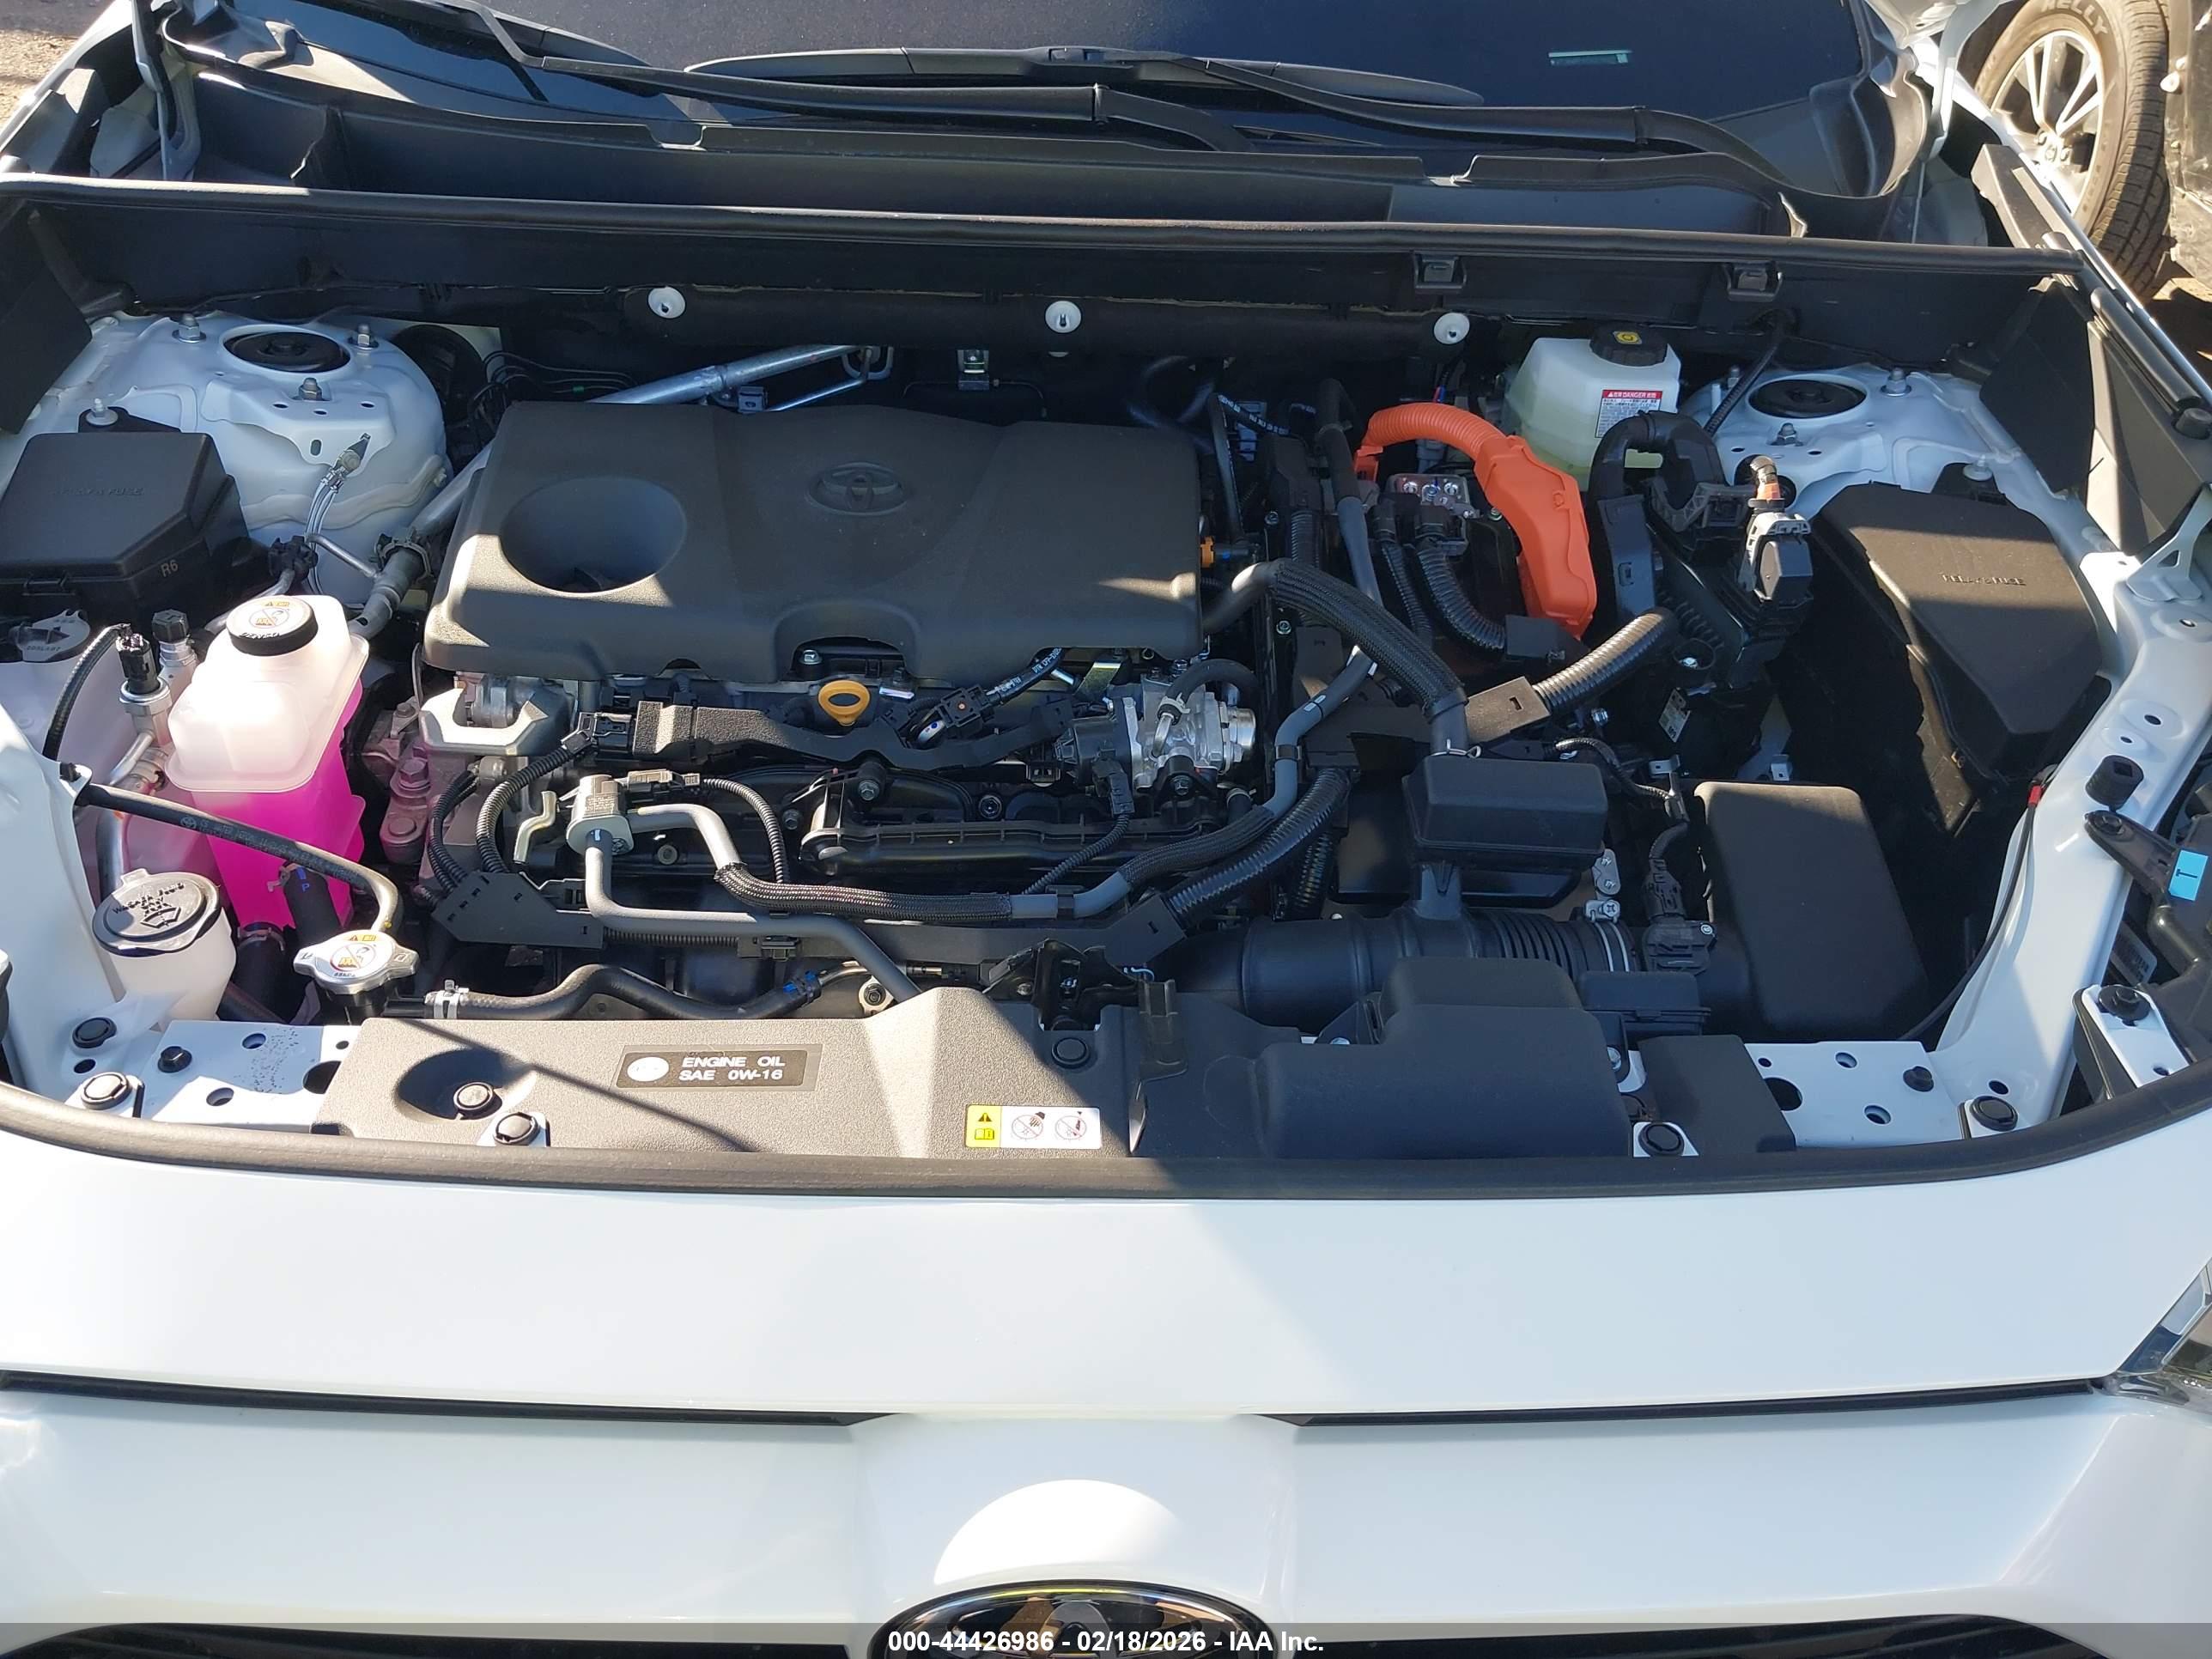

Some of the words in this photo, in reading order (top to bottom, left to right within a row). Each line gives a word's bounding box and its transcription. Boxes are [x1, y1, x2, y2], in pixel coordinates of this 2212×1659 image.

[161, 559, 179, 578] R6
[682, 1056, 746, 1067] ENGINE
[757, 1056, 786, 1067] OIL
[678, 1070, 716, 1081] SAE
[727, 1069, 783, 1080] 0W-16
